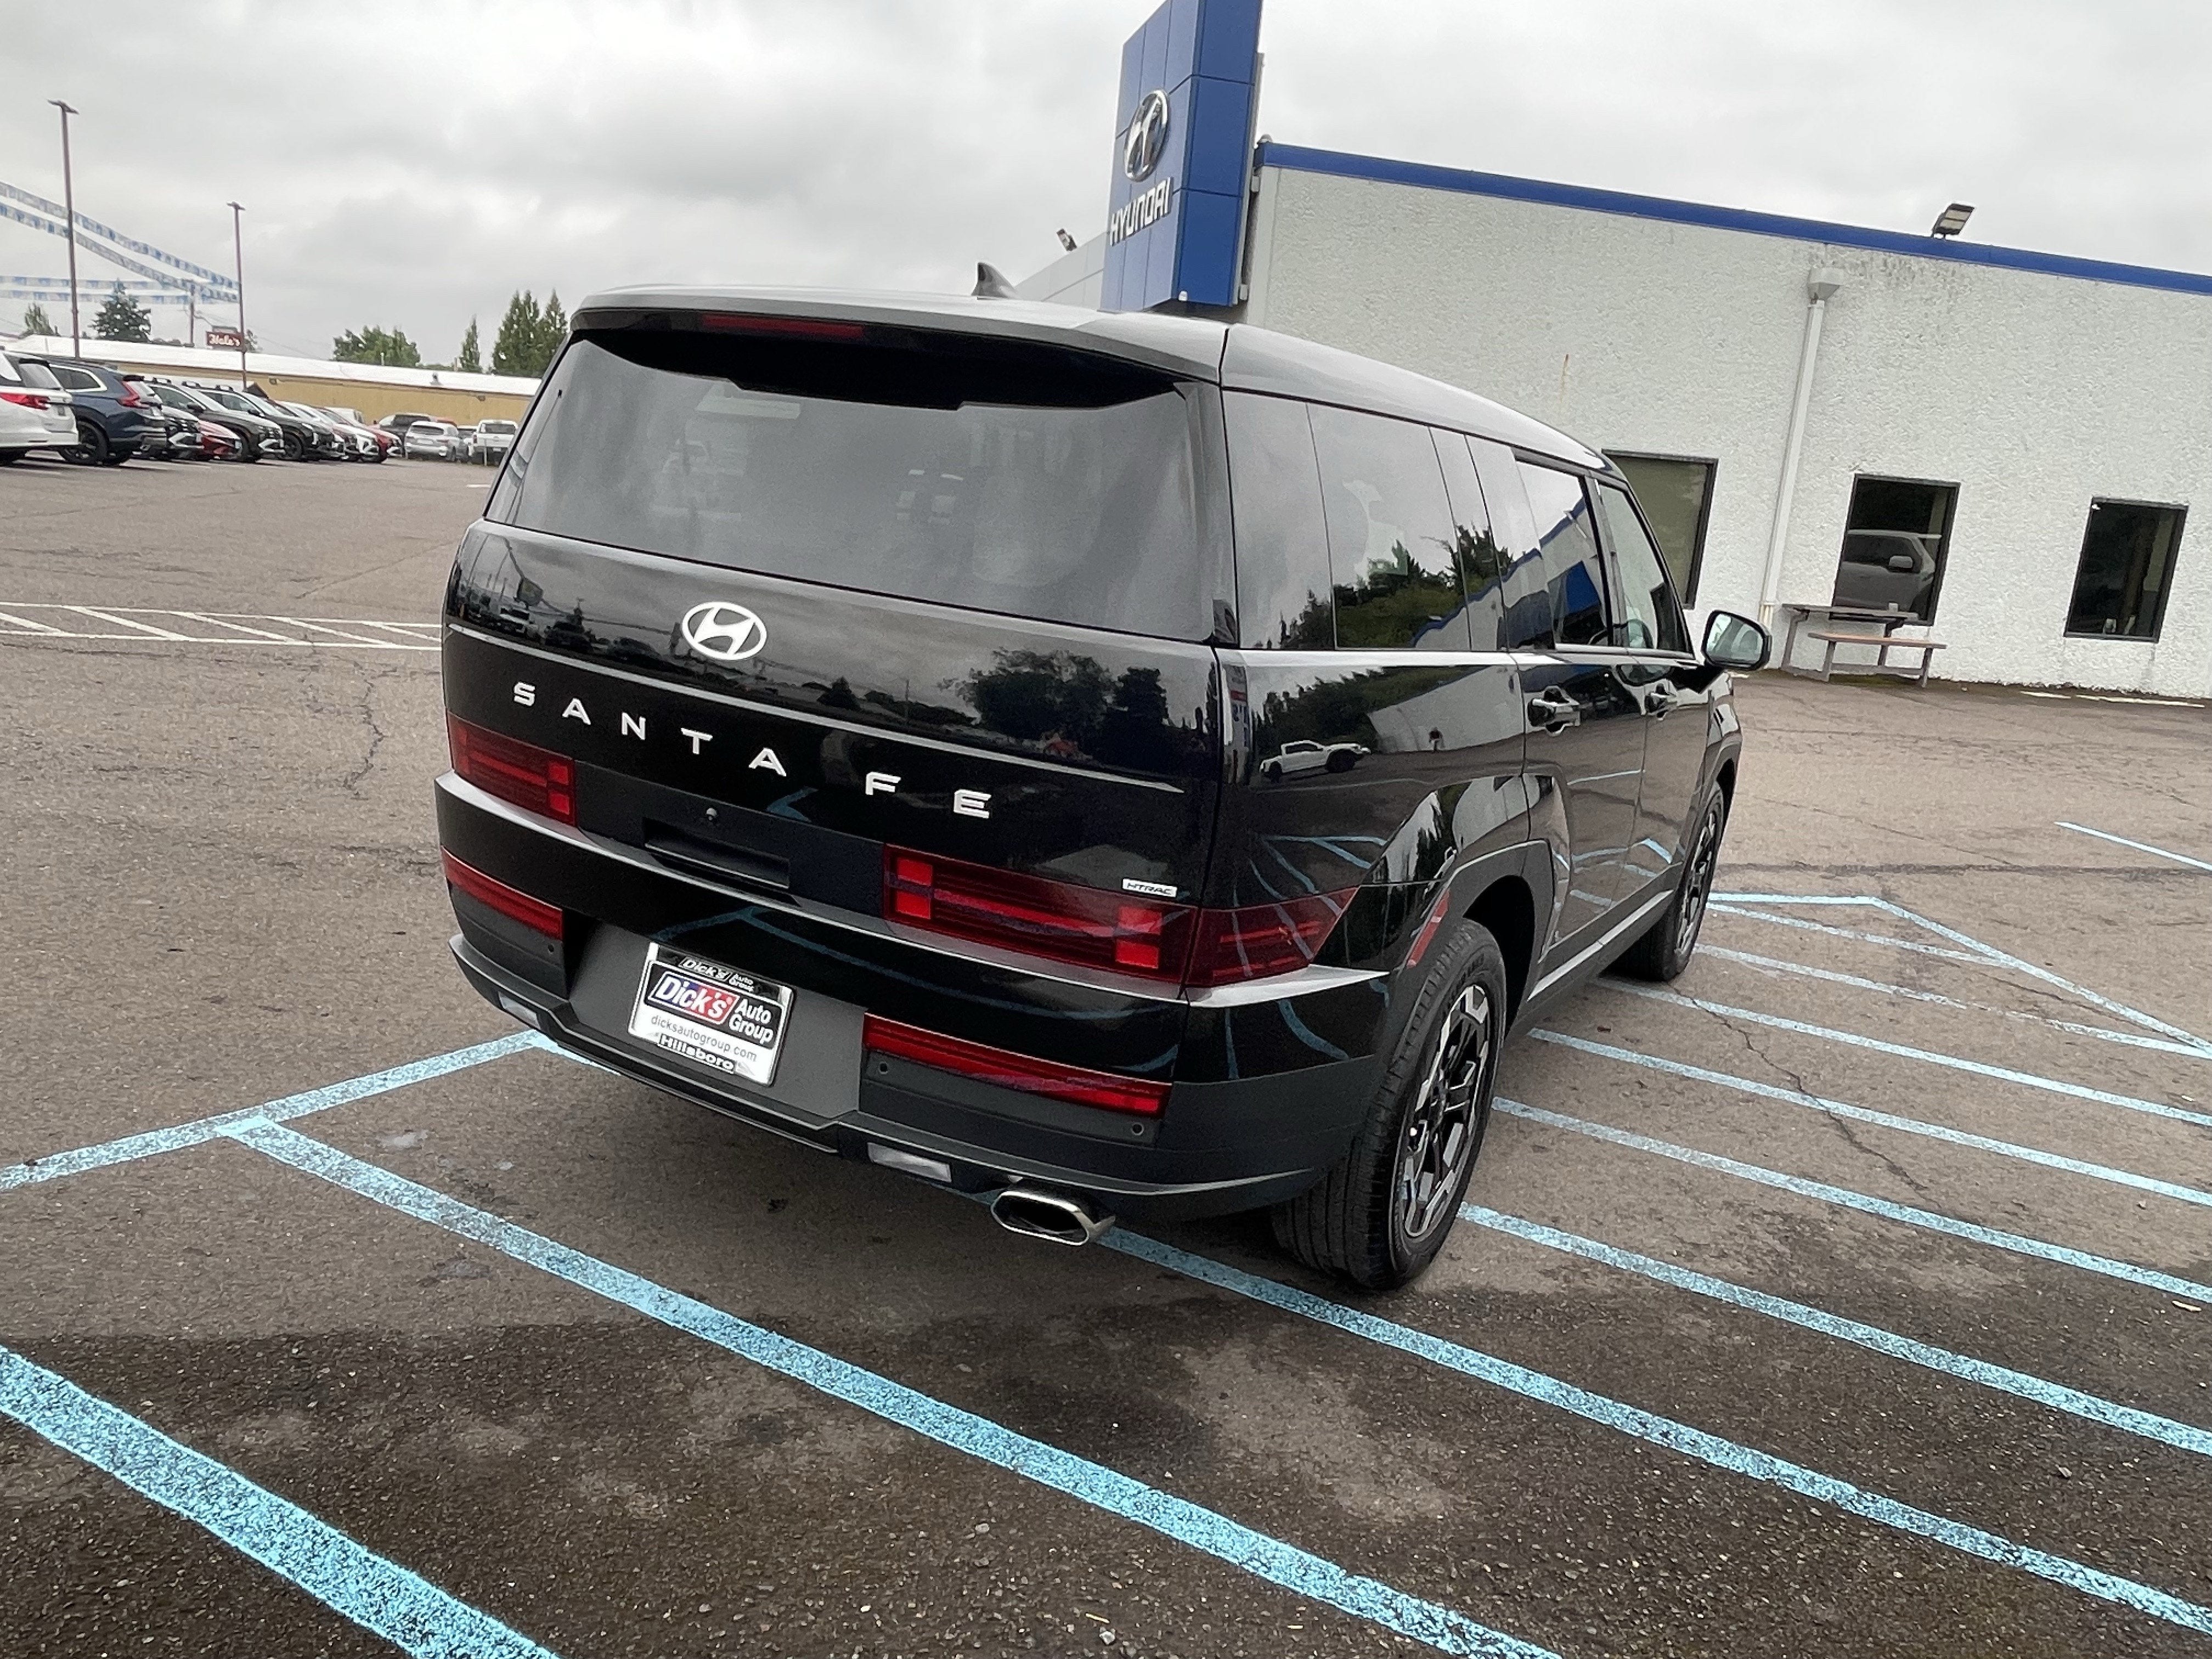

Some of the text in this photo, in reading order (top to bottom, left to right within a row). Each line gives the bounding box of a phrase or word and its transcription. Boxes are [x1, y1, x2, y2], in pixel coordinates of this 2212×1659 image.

[1109, 177, 1173, 247] HYUNDAI
[514, 682, 992, 819] SANTA FE
[1127, 882, 1172, 895] HTRAC
[655, 975, 727, 1018] Dick's
[735, 998, 771, 1024] Auto
[651, 1015, 757, 1062] dicksautogroup.com
[729, 1014, 774, 1044] Group
[659, 1034, 734, 1070] Hillsboro
